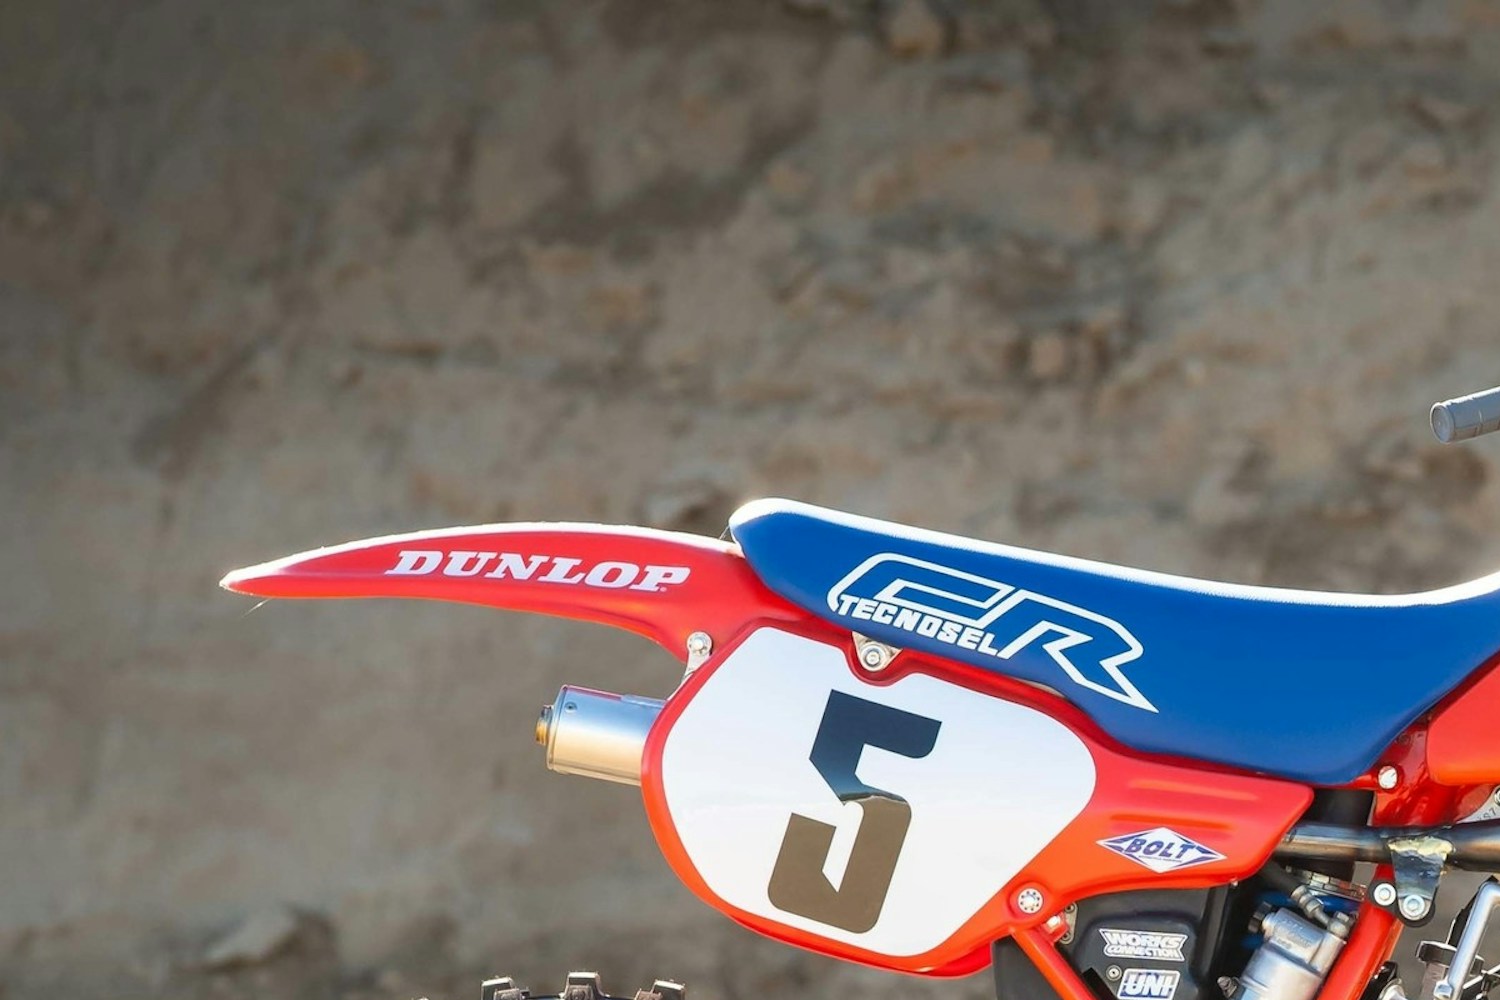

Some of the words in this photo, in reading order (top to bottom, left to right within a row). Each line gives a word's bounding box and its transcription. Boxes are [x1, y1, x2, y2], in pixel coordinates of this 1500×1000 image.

[384, 550, 691, 592] DUNLOP
[827, 552, 1159, 713] CR
[837, 595, 1004, 657] TECNOSEL
[768, 689, 942, 934] 5
[1124, 838, 1196, 859] BOLT
[1105, 933, 1181, 949] WORKS
[1107, 946, 1179, 958] CONNECTION
